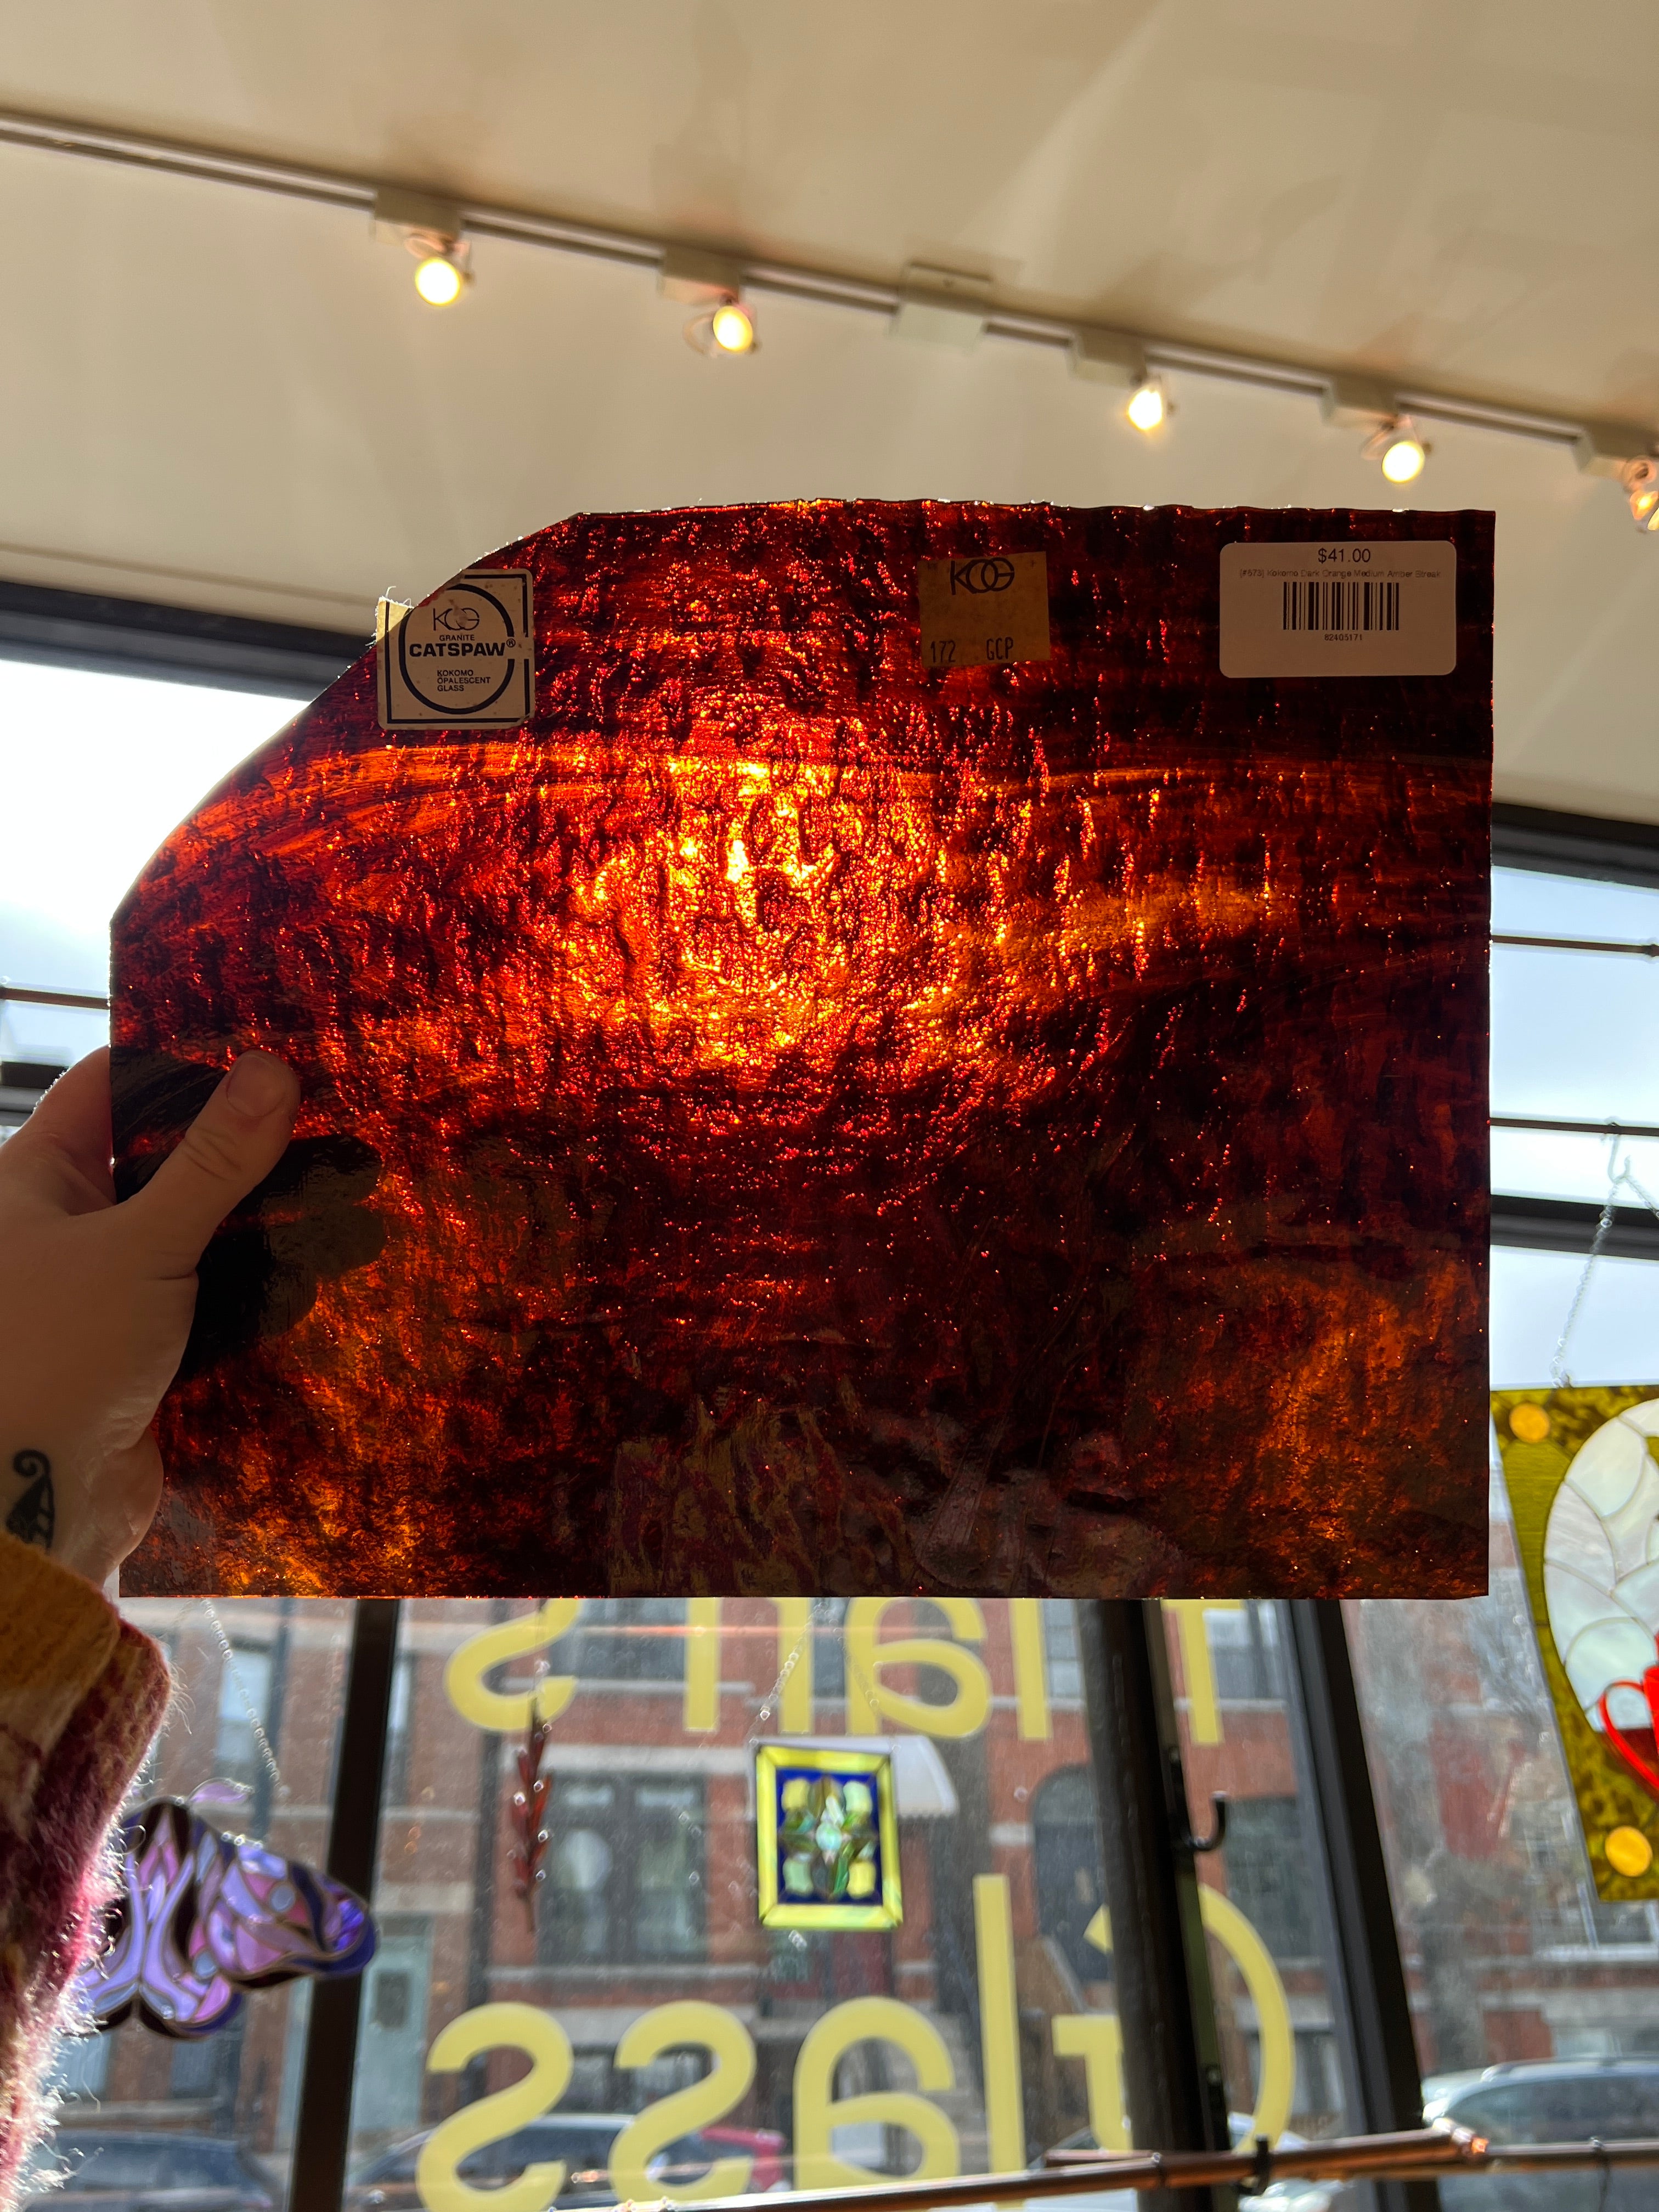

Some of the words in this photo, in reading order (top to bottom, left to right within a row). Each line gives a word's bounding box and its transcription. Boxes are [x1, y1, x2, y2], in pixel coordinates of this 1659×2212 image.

[1318, 548, 1371, 563] $41.00
[1322, 569, 1351, 579] Orange
[930, 640, 956, 663] 172
[986, 636, 1014, 660] GCP
